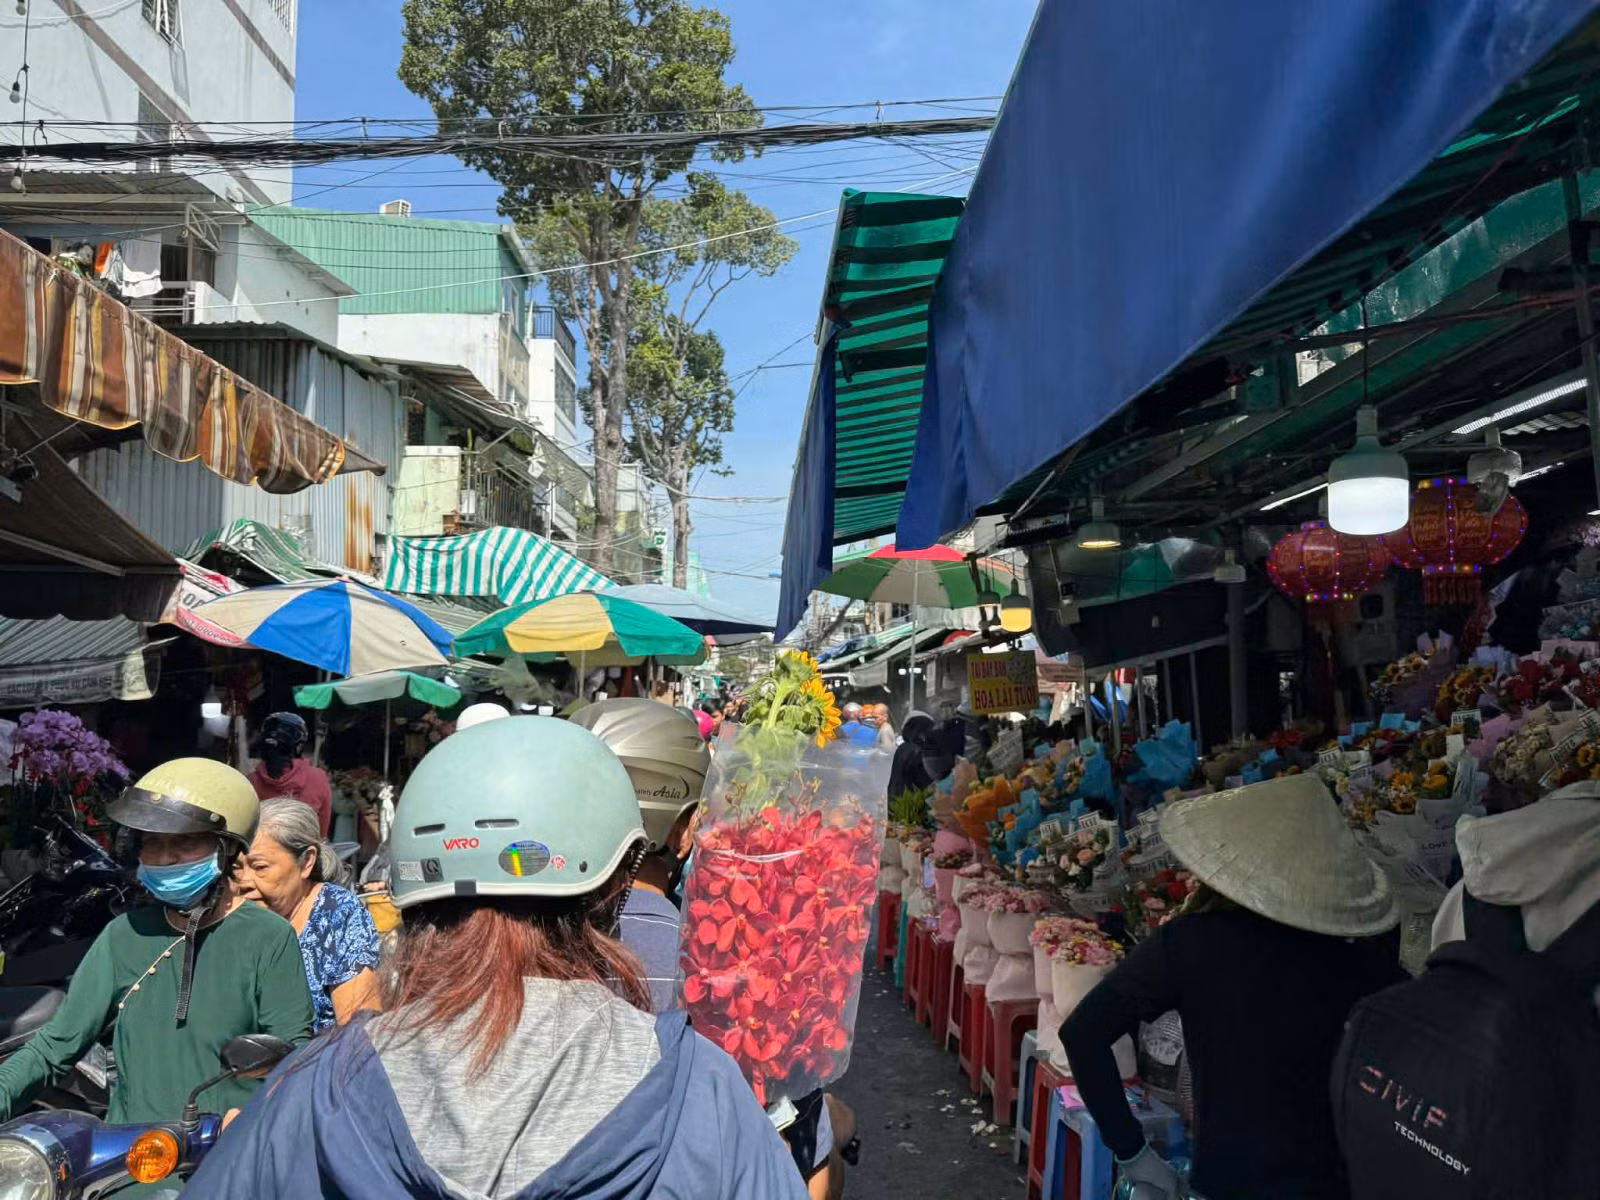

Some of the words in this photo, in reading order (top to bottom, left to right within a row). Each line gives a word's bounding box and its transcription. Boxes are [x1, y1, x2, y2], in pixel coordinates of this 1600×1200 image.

[653, 785, 681, 799] Asia
[442, 837, 480, 851] VARO
[1394, 1120, 1471, 1176] TECHNOLOGY
